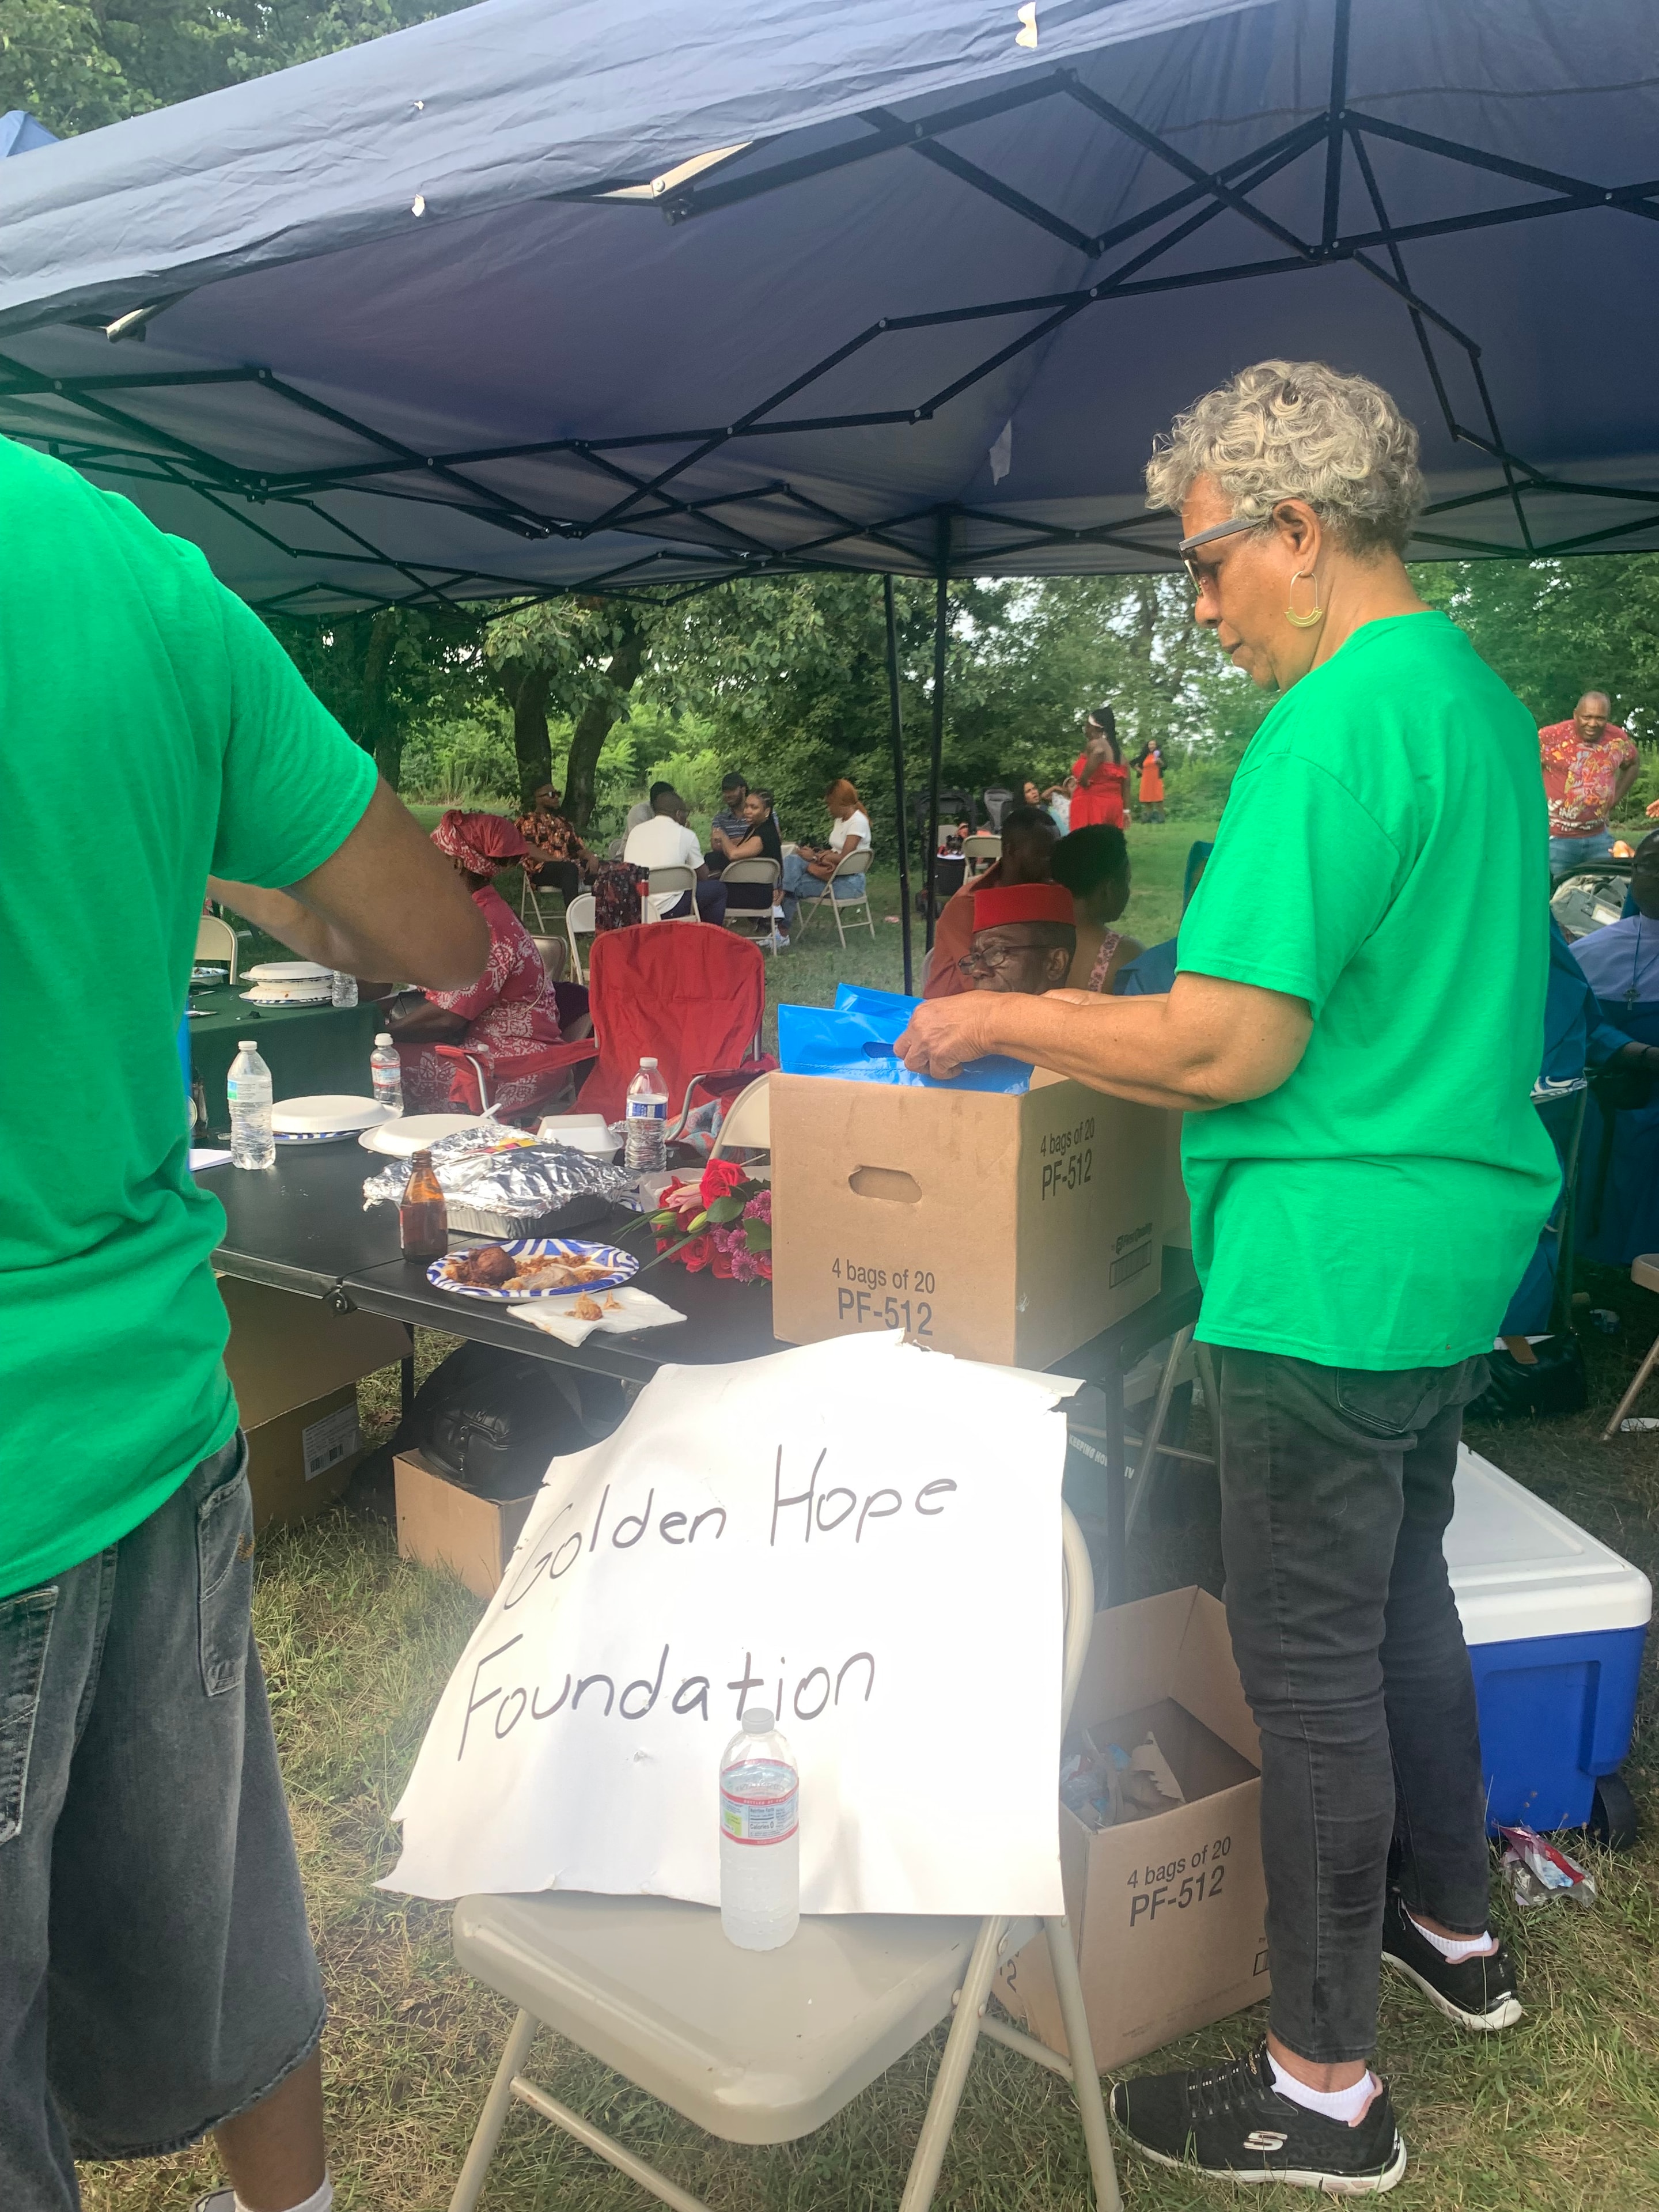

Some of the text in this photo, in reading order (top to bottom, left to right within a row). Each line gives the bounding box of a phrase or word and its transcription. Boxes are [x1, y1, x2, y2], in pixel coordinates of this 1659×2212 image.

[1040, 1117, 1095, 1157] 4 bags of 20
[1041, 1148, 1092, 1201] PF-512
[832, 1257, 935, 1294] 4 bags of 20
[838, 1287, 933, 1336] PF-512
[503, 1444, 957, 1611] Golden Hope
[457, 1633, 875, 1761] Foundation
[1127, 1836, 1231, 1888] 4 bags of 20
[1130, 1865, 1225, 1927] PF-512
